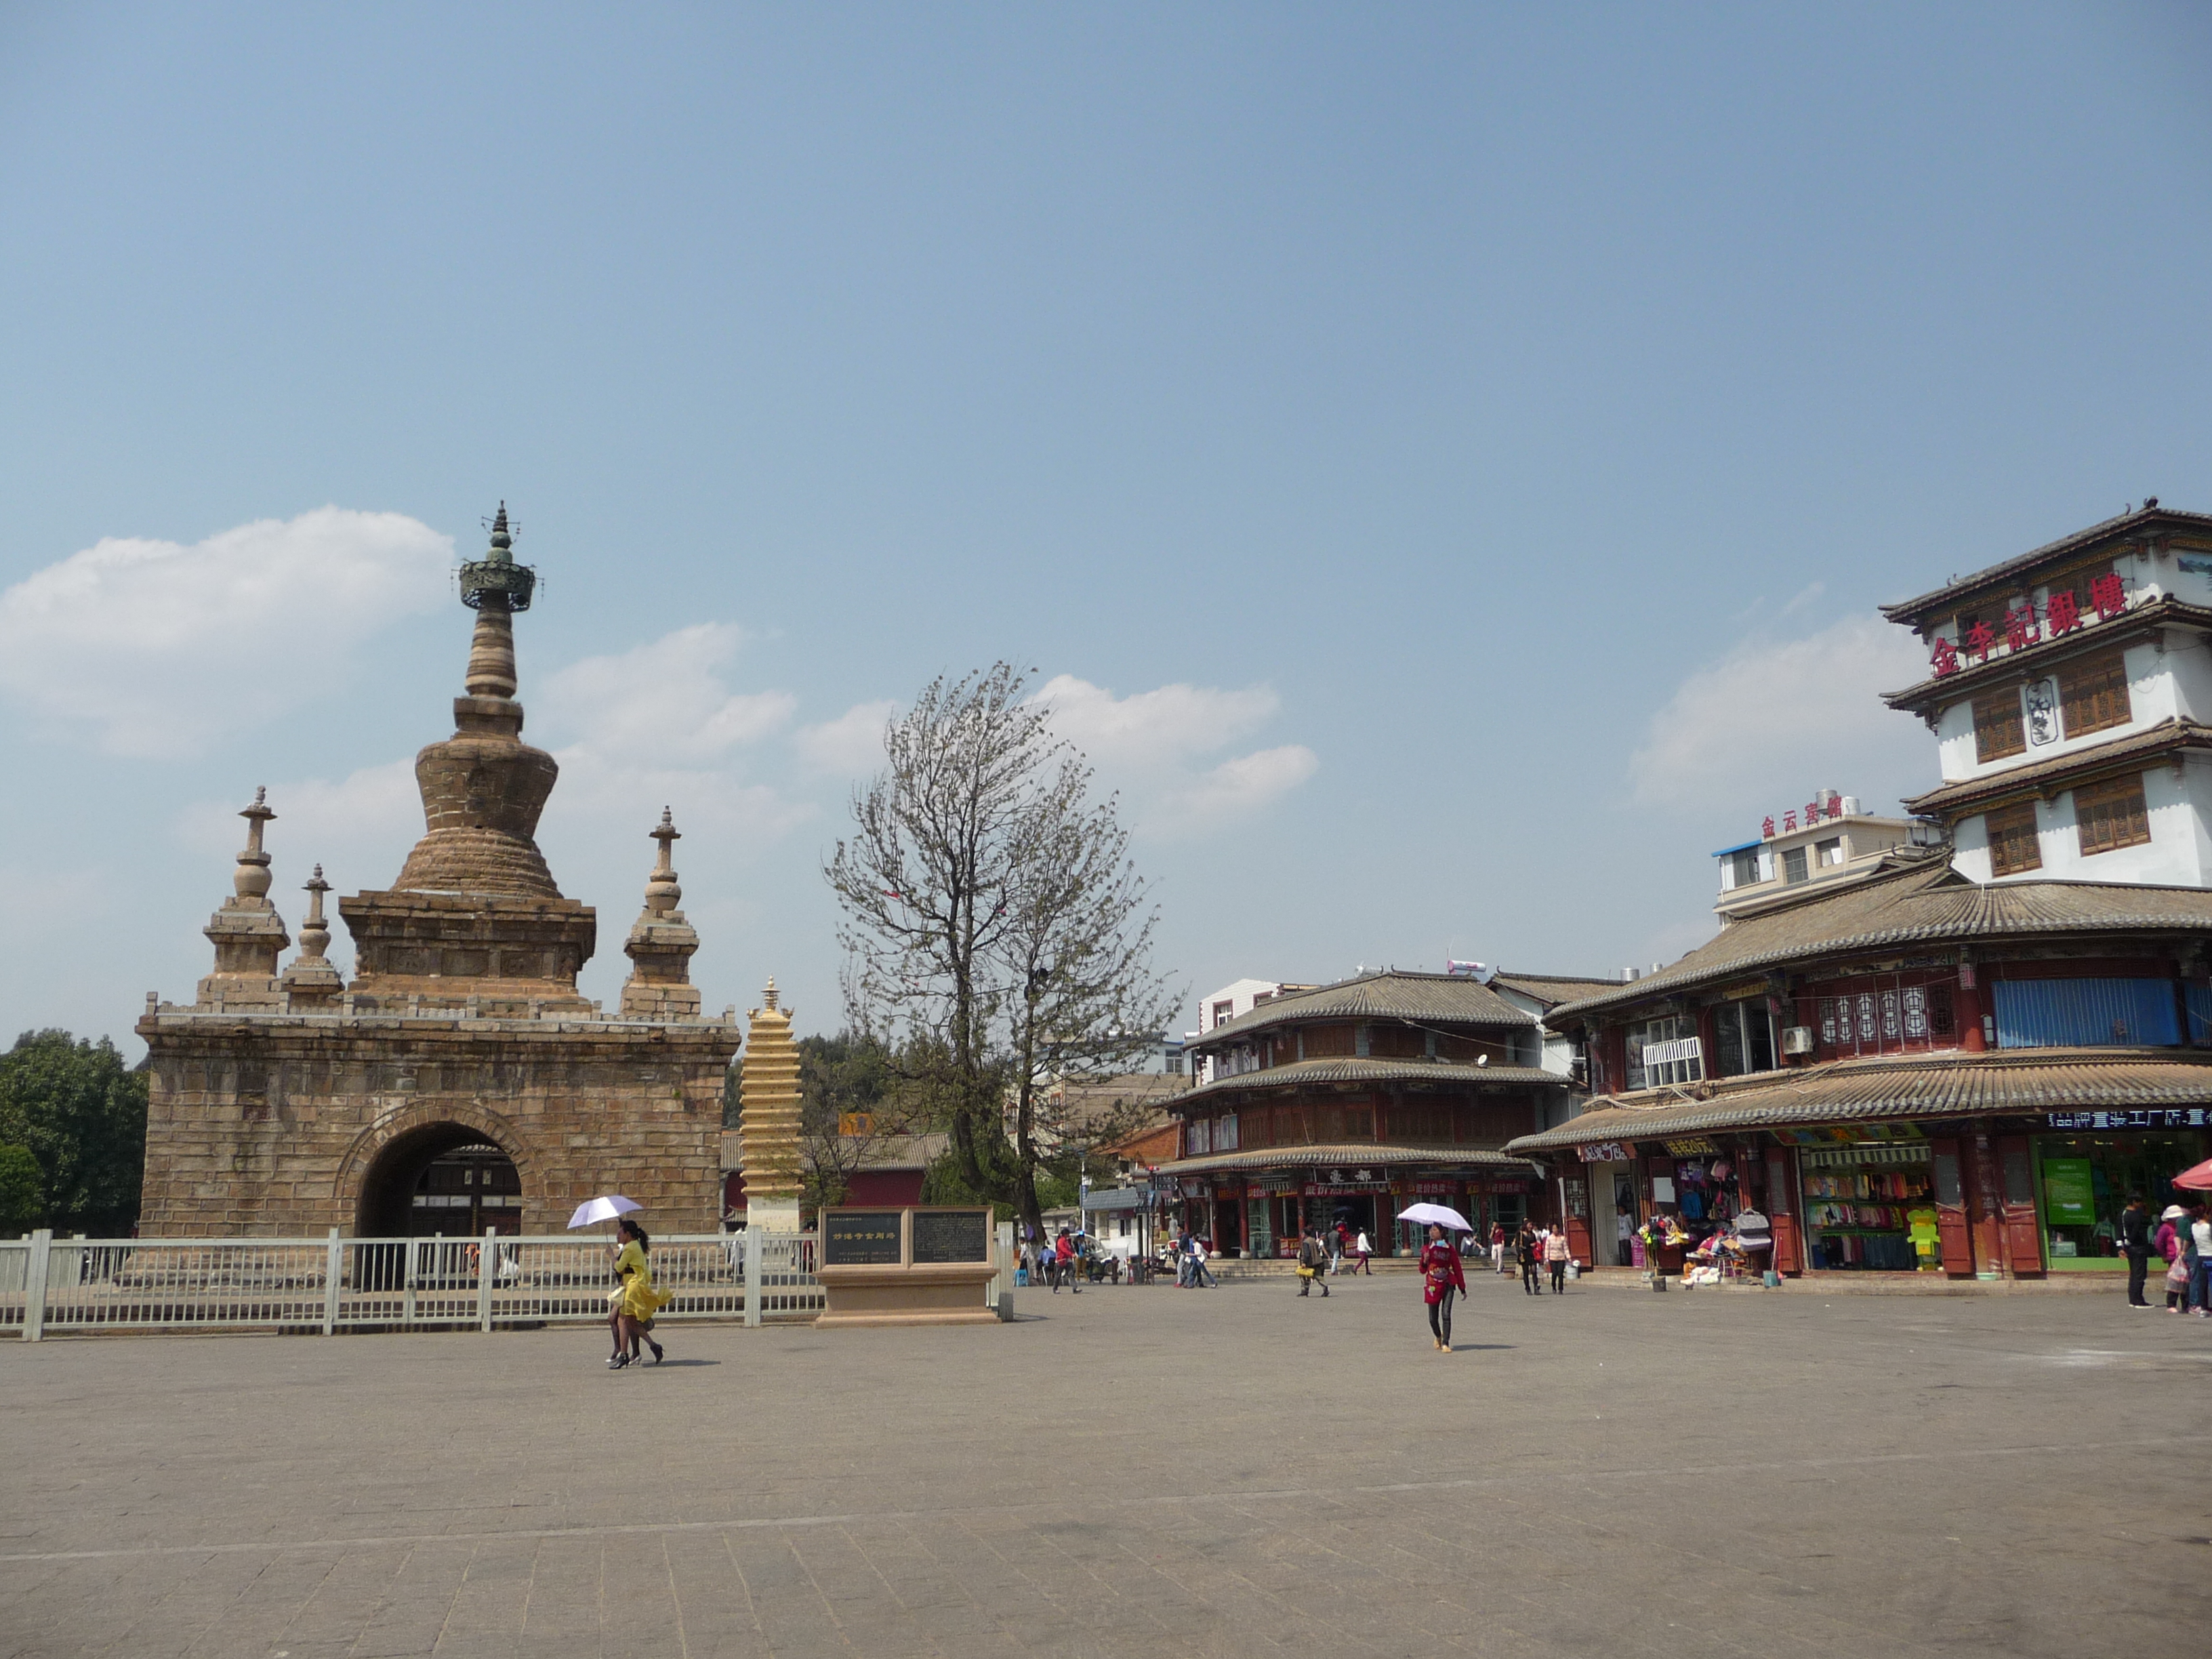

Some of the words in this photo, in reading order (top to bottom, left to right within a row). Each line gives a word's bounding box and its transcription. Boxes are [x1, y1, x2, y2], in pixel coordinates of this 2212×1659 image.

[1930, 573, 2127, 678] 金李記銀樓
